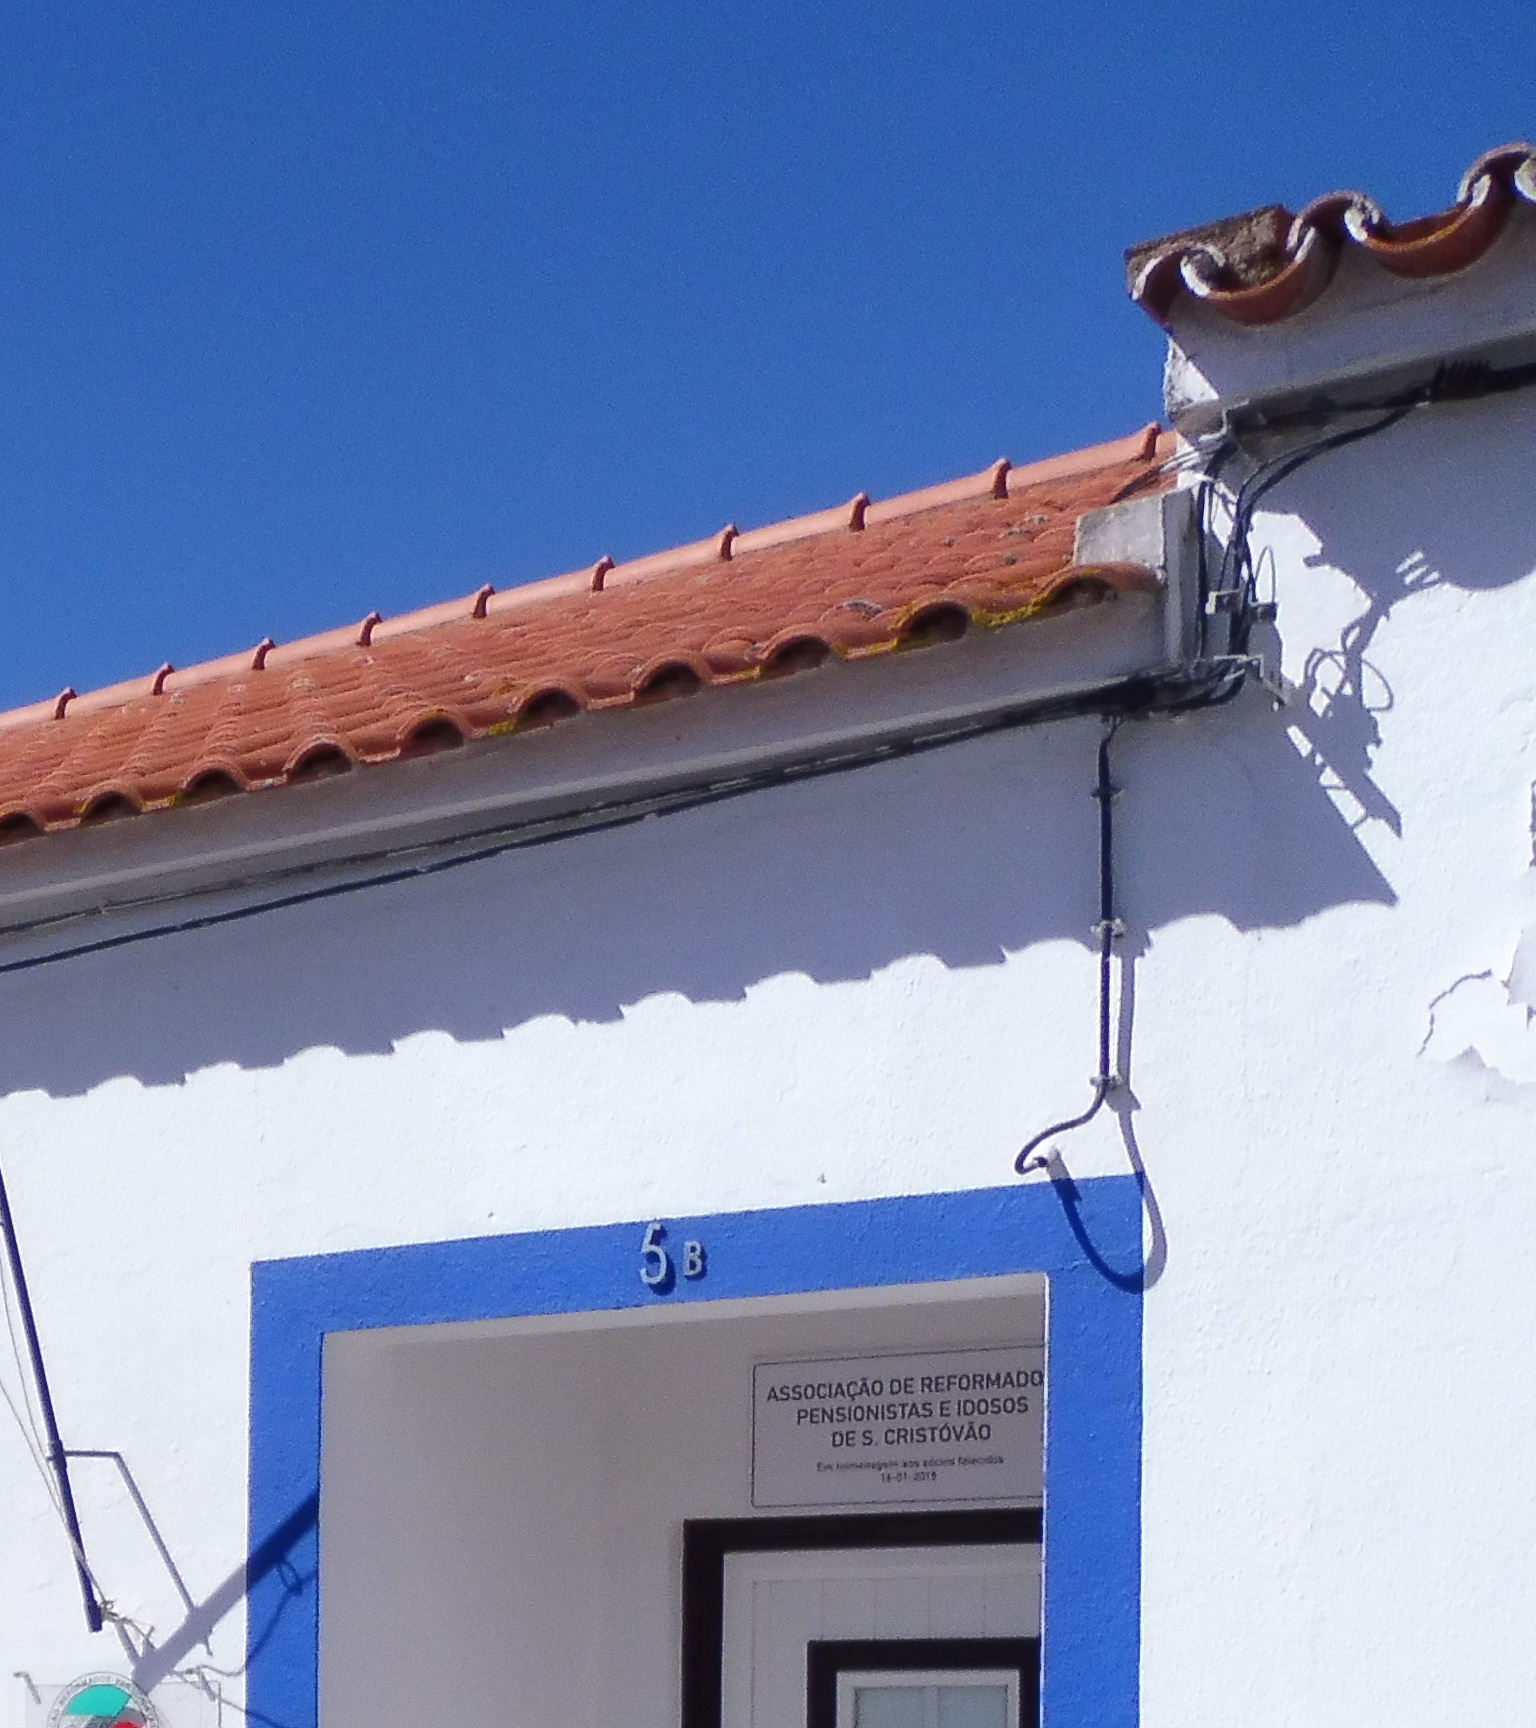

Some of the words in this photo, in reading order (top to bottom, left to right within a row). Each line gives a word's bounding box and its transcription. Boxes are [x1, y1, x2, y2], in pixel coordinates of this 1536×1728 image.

[639, 1222, 668, 1284] 5
[682, 1239, 703, 1277] B
[766, 1378, 884, 1402] ASSOCIAÇÃO
[889, 1376, 915, 1395] DE
[920, 1369, 1044, 1393] REFORMADO
[796, 1402, 934, 1425] PENSIONISTAS
[939, 1400, 951, 1417] E
[956, 1396, 1030, 1416] IDOSOS
[831, 1430, 856, 1448] DE
[862, 1429, 878, 1447] S.
[883, 1422, 992, 1446] CRISTÓVÃO
